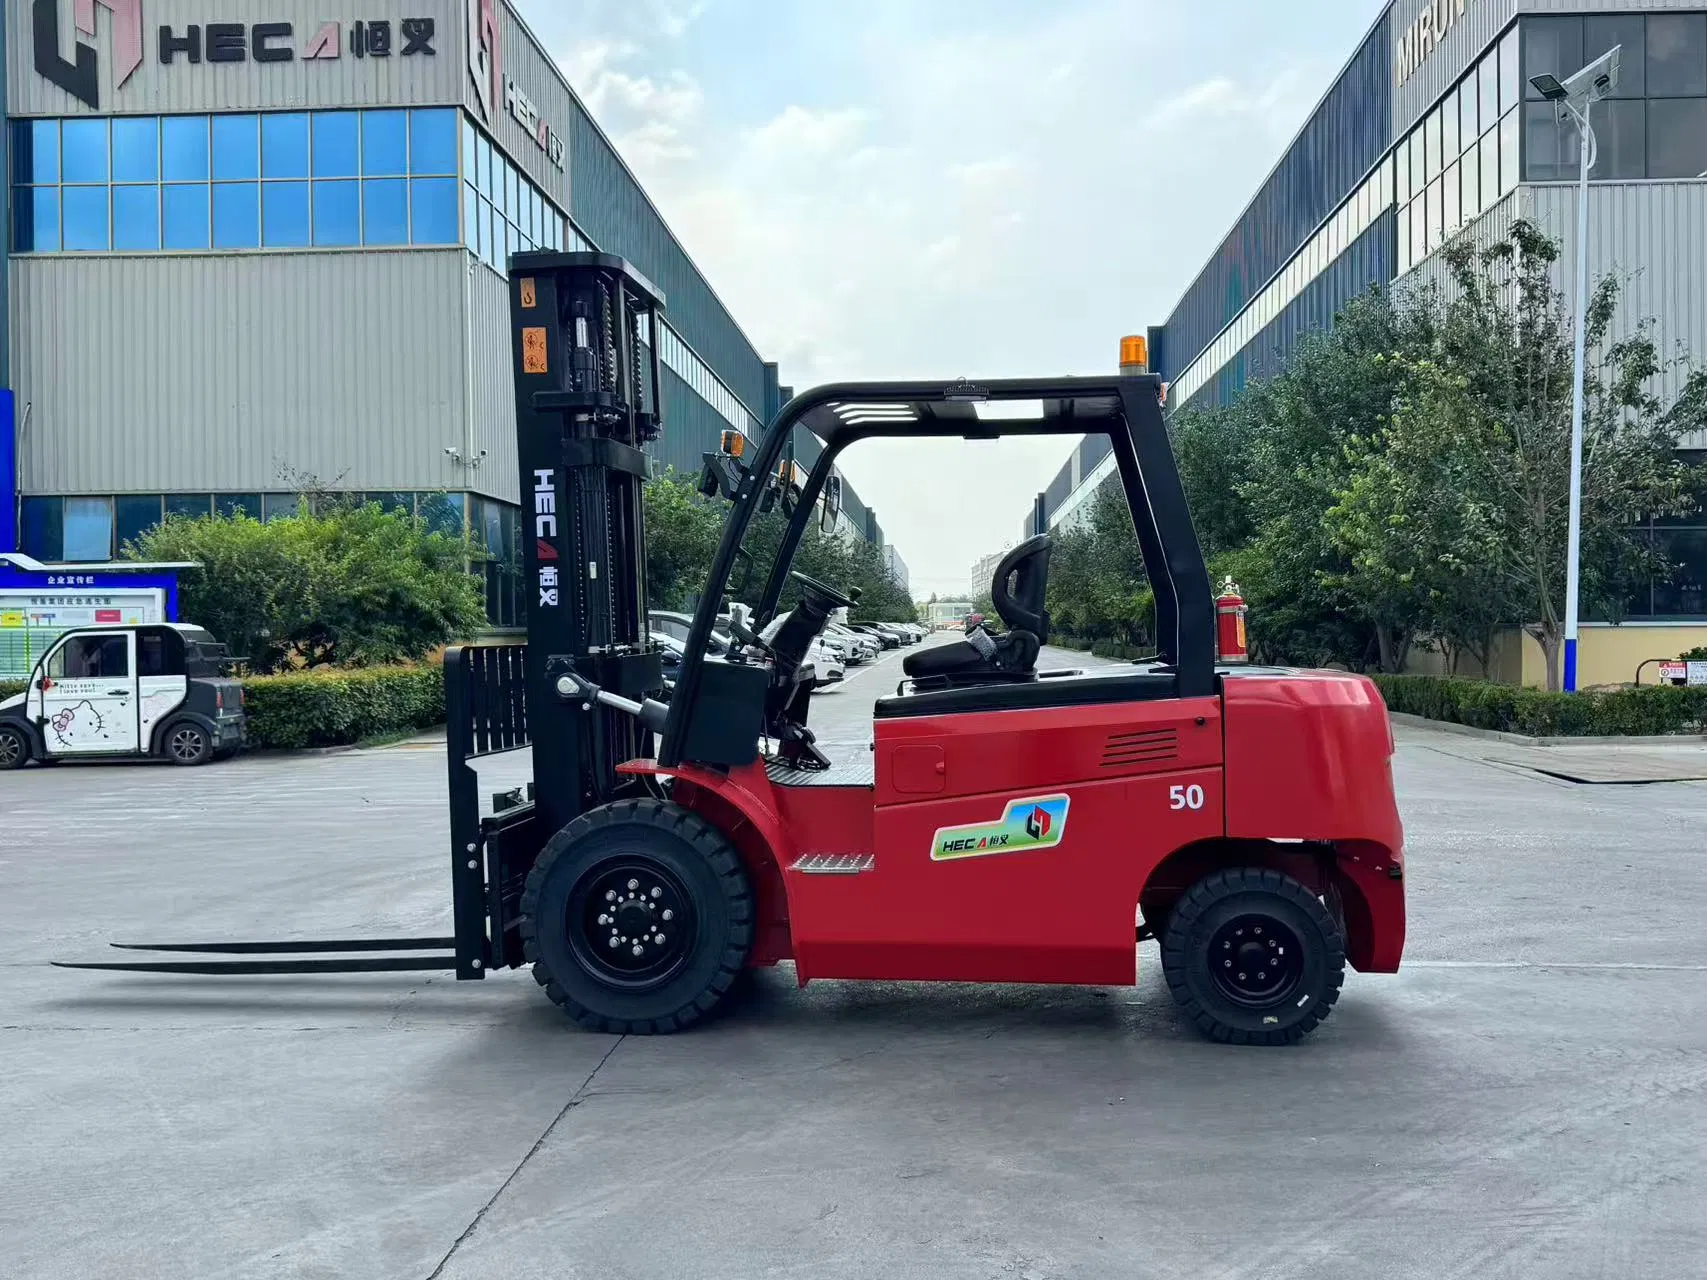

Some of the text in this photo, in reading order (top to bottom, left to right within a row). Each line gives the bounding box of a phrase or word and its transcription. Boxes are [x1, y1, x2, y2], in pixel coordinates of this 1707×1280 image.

[159, 21, 341, 64] HECA
[534, 469, 559, 560] HECA
[1170, 784, 1204, 810] 50
[943, 837, 987, 852] HECA
